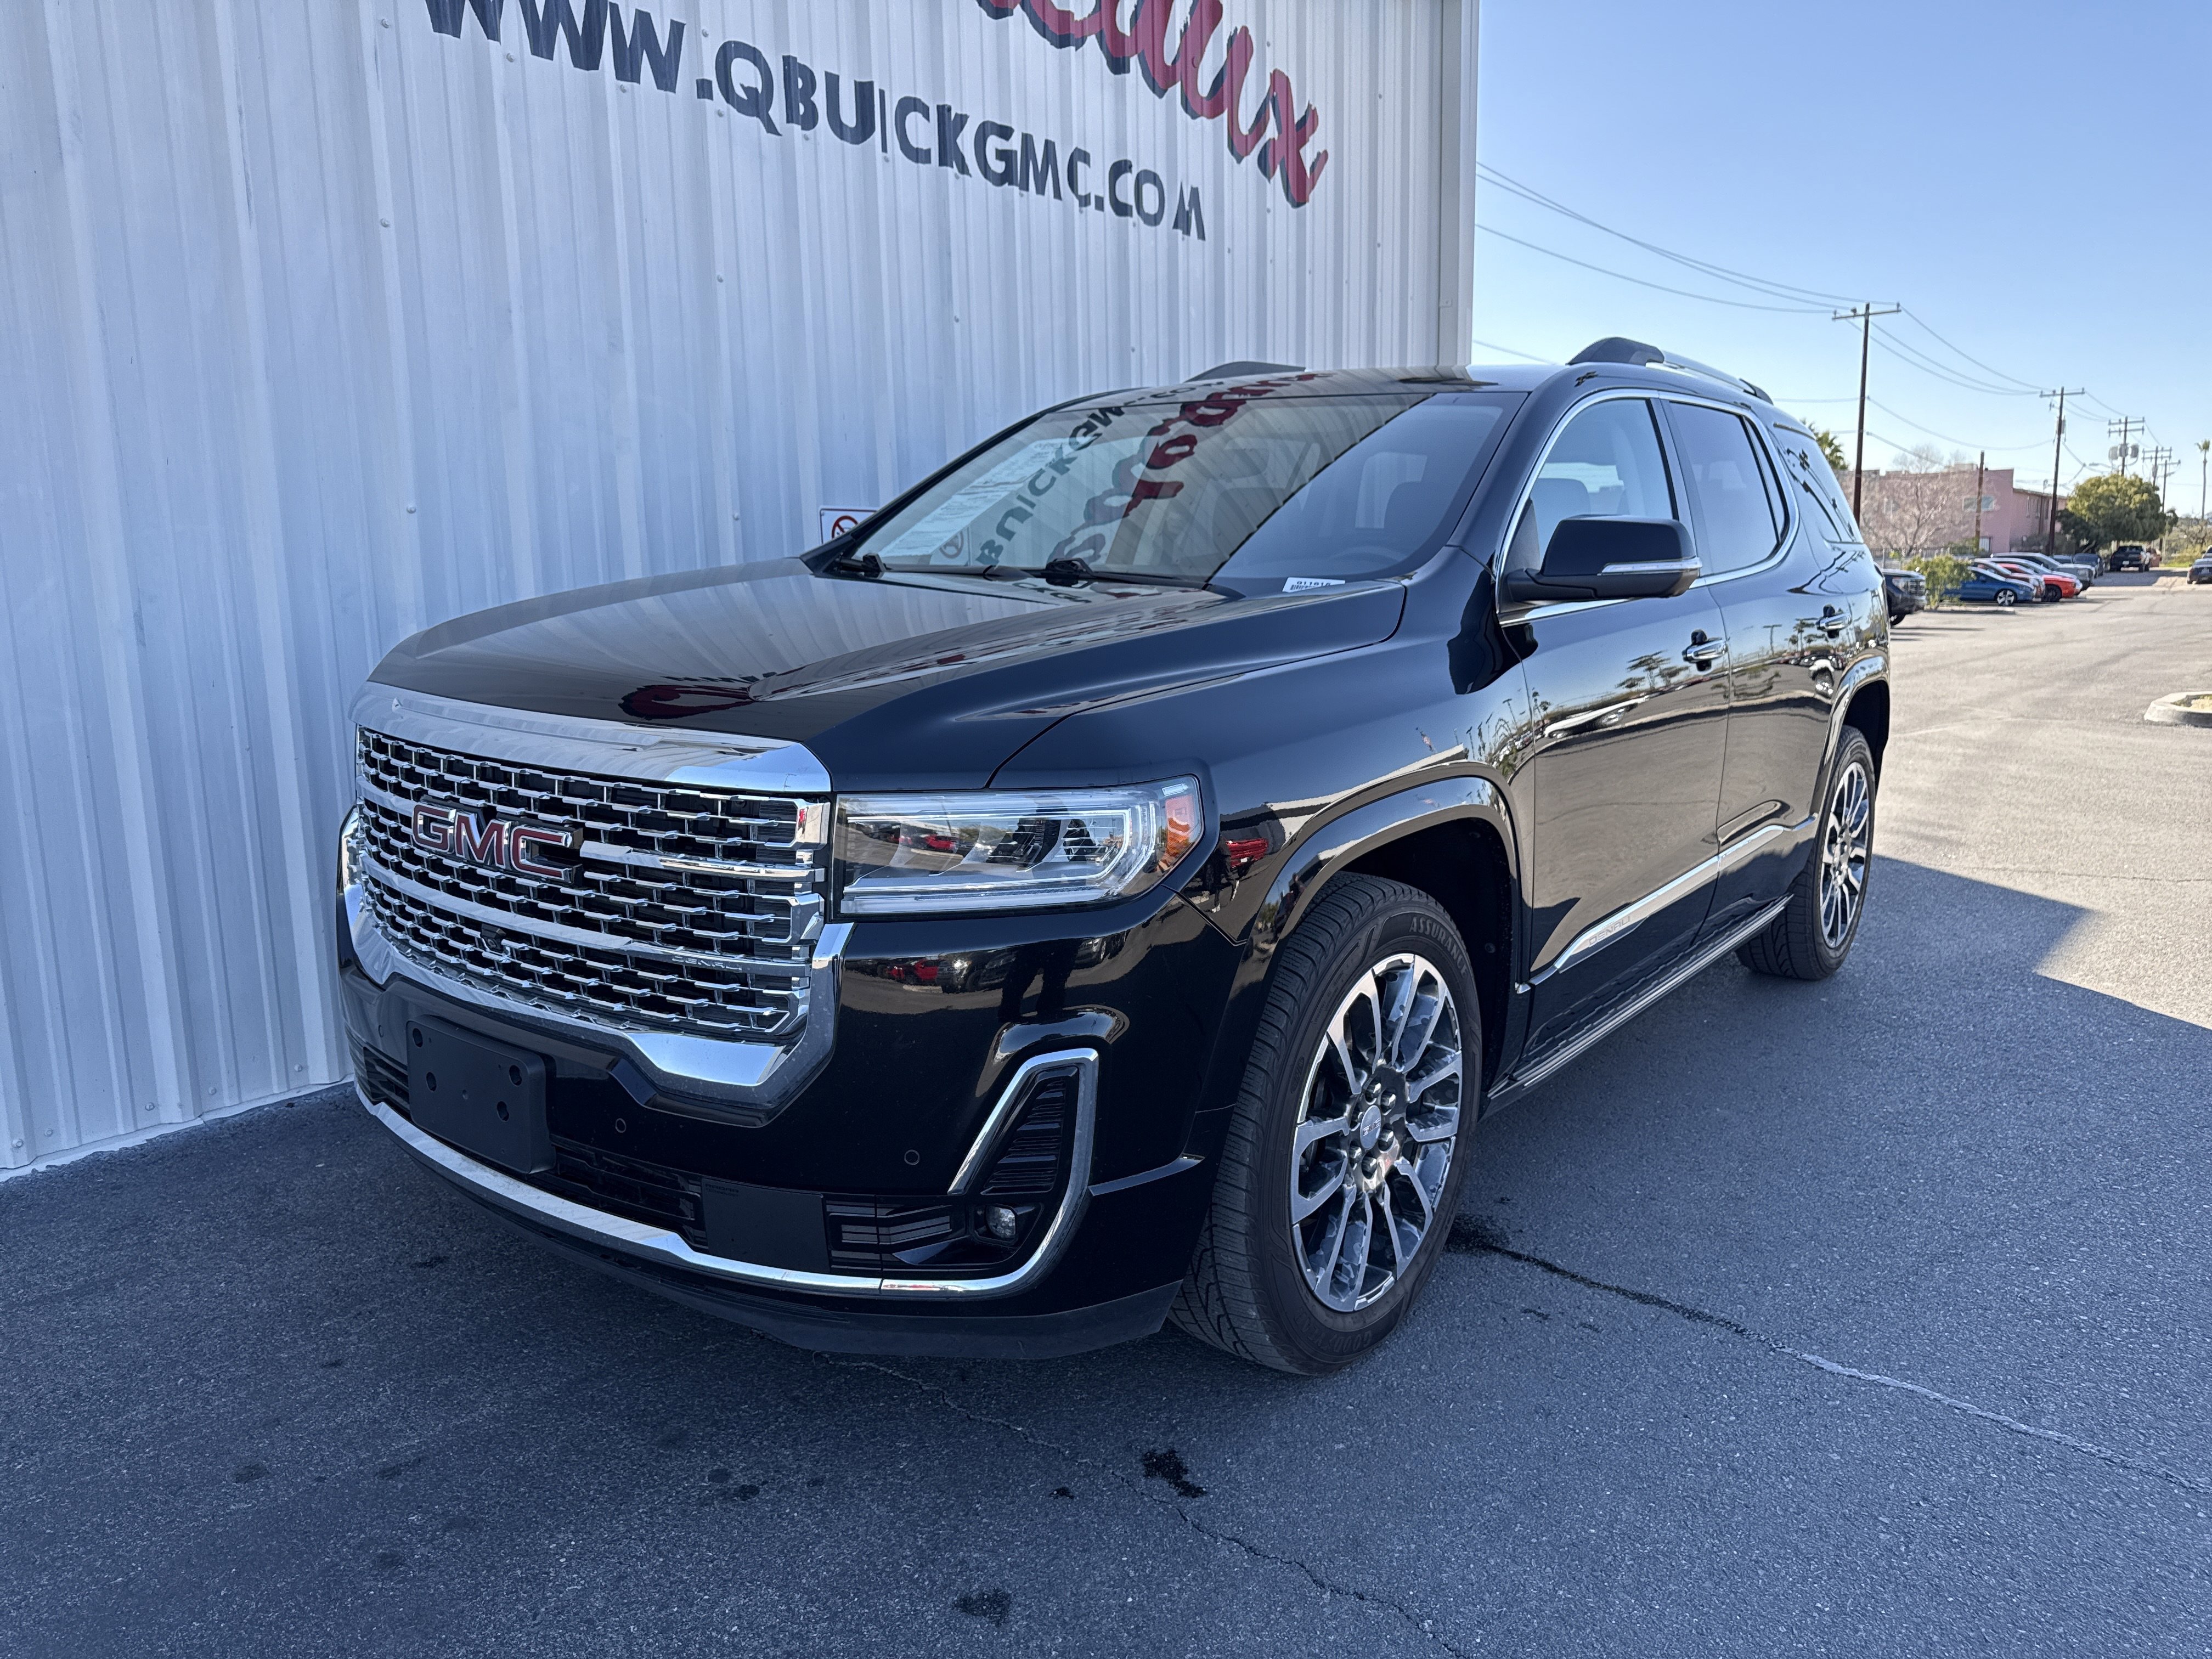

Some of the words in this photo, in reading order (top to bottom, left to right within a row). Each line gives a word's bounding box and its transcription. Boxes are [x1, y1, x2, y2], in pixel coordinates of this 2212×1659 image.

[413, 802, 572, 882] GMC
[1409, 916, 1469, 977] ASSURANCE
[1589, 916, 1630, 945] DENALI
